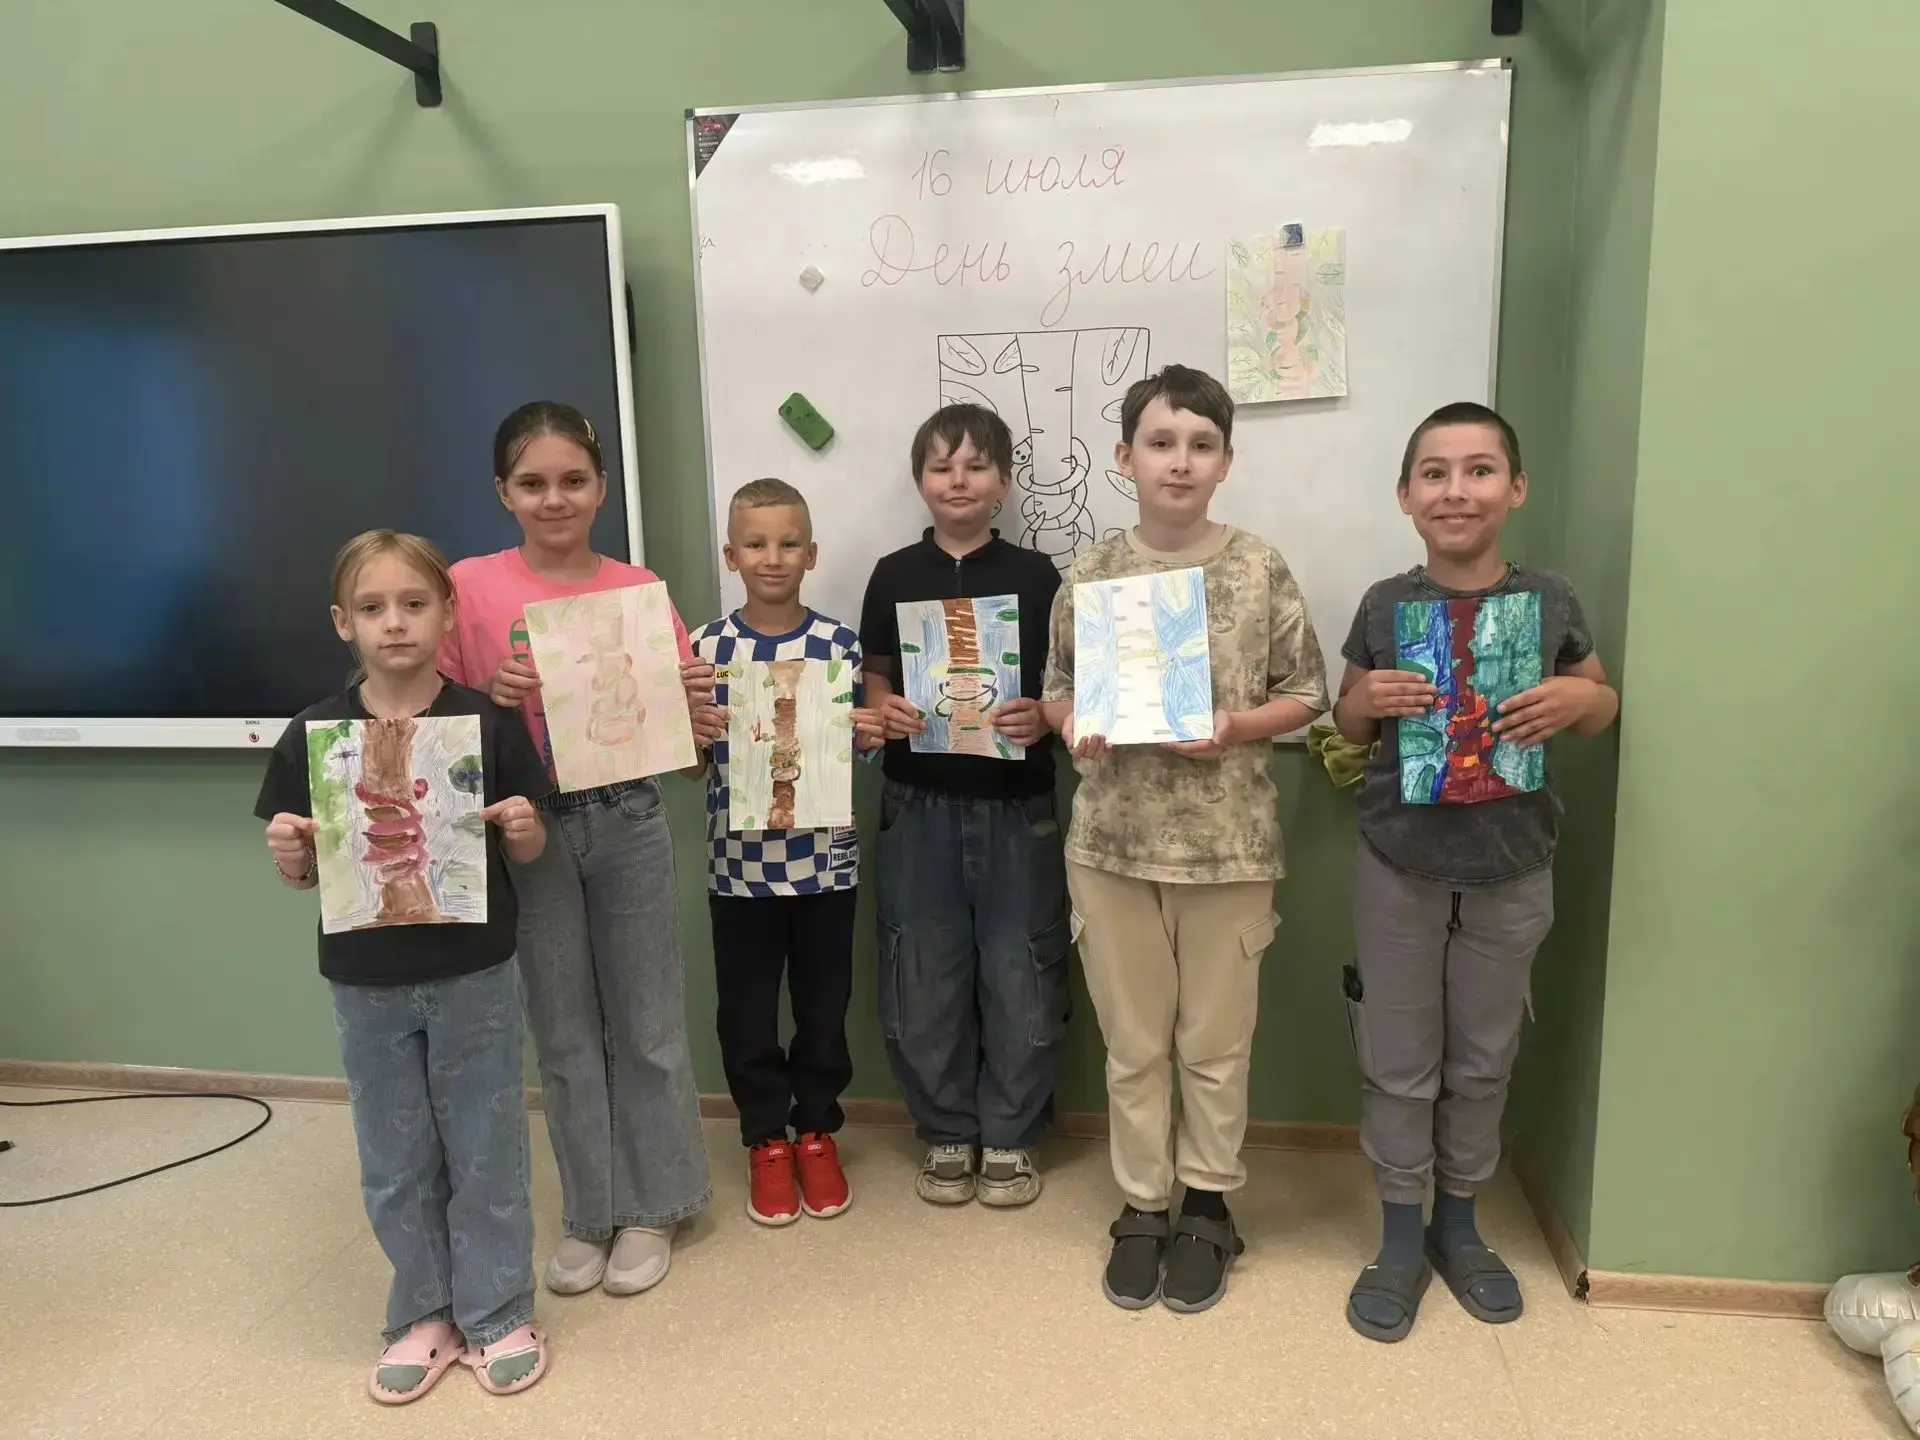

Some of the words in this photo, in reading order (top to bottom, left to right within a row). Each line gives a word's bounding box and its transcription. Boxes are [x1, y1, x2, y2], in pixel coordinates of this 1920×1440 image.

[911, 149, 952, 200] 16
[985, 148, 1125, 195] июля
[860, 214, 1011, 287] День
[1040, 240, 1216, 327] змеи
